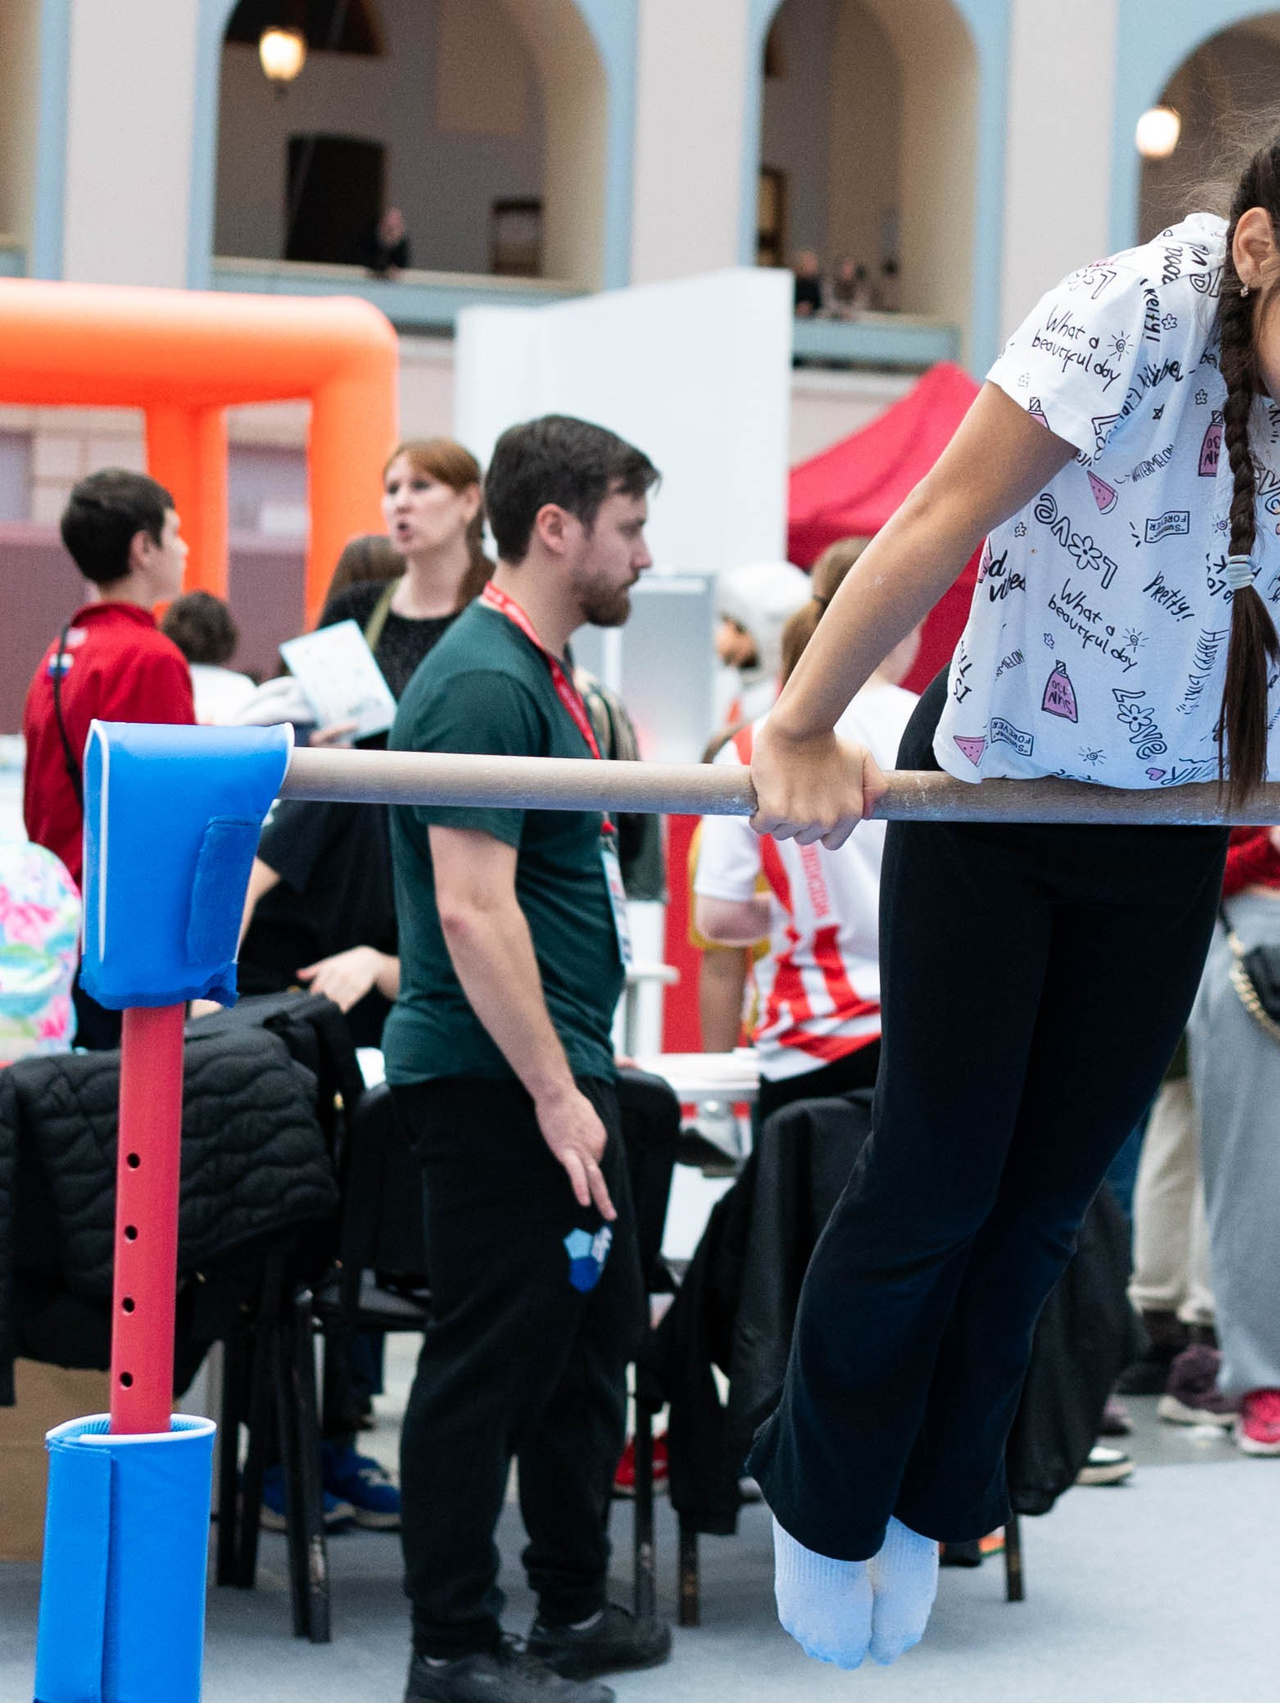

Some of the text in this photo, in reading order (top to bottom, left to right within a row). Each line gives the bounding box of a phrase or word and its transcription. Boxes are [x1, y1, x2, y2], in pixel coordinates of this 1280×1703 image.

[1045, 304, 1100, 350] What a
[1031, 328, 1090, 374] beautiful
[1092, 359, 1122, 393] day
[1048, 593, 1138, 673] beautiful day
[1060, 578, 1116, 637] What a
